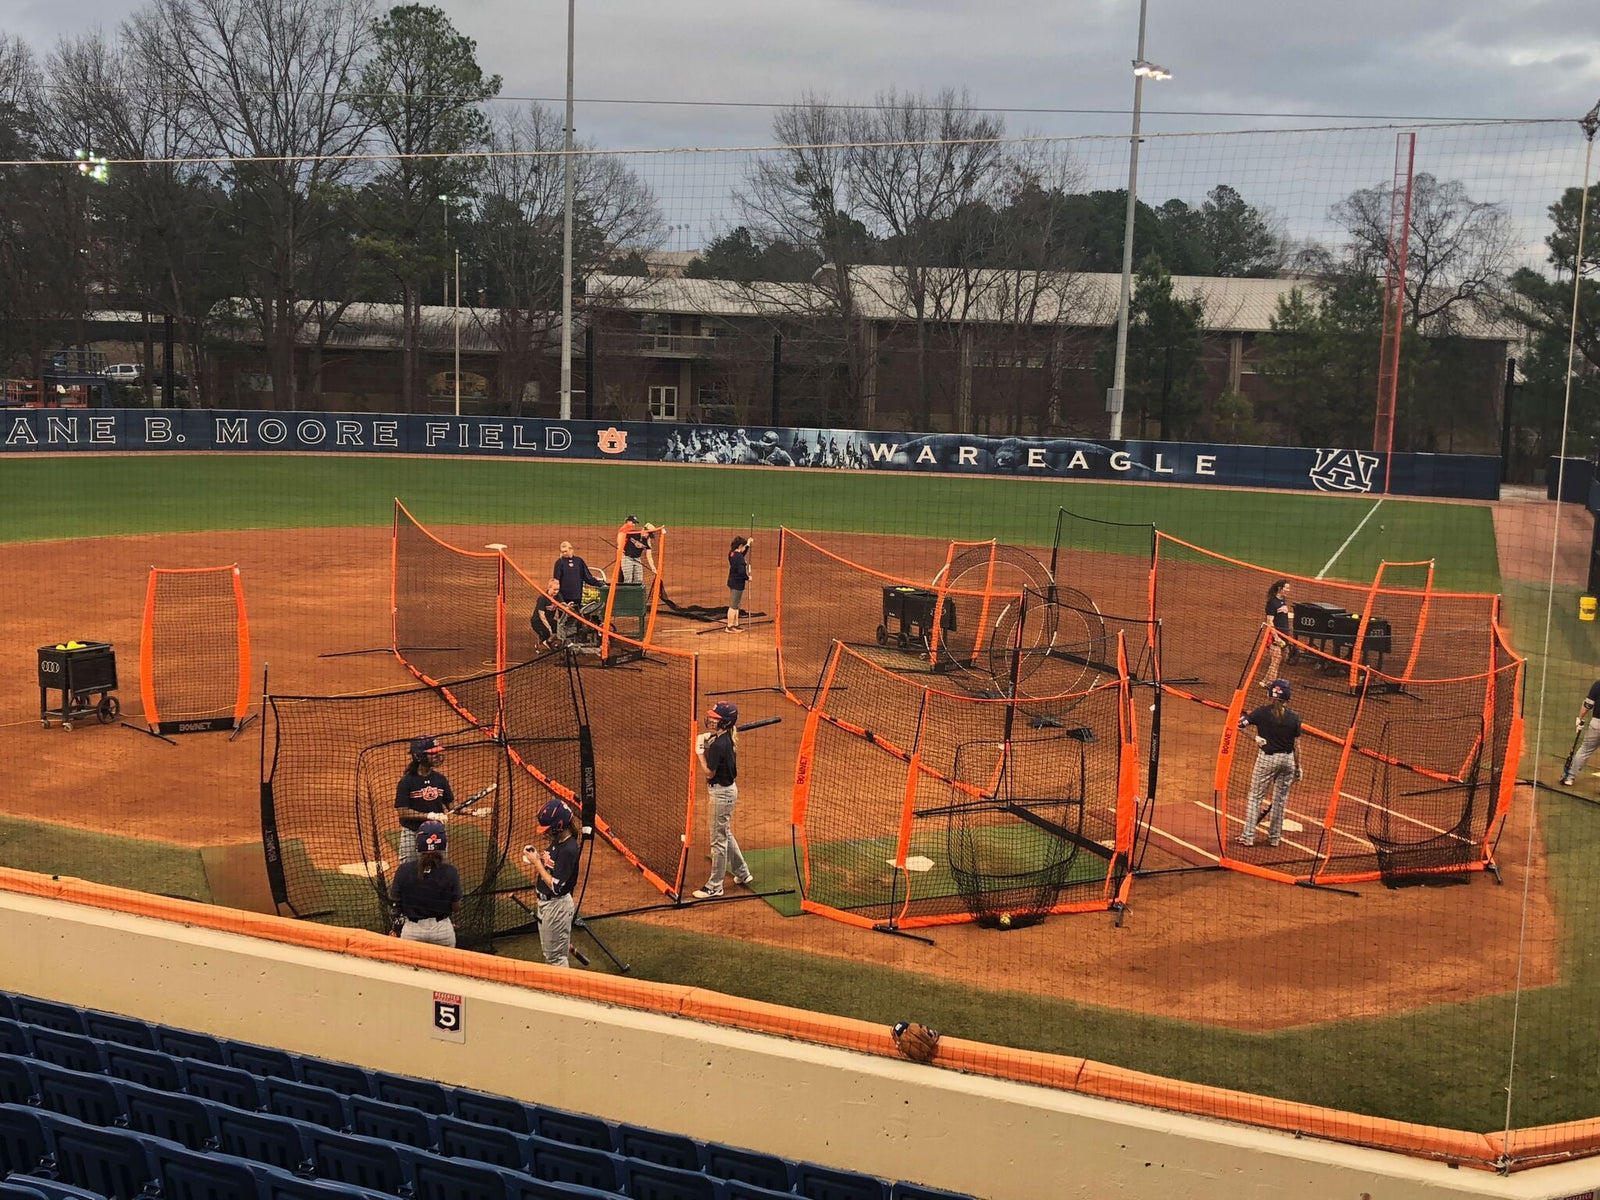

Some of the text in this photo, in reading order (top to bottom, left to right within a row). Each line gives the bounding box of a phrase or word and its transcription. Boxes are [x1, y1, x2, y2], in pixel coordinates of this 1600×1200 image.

[6, 416, 572, 452] ANE B. MOORE FIELD
[868, 443, 1217, 476] WAR EAGLE
[797, 755, 807, 783] BOWNET
[439, 1006, 456, 1027] 5
